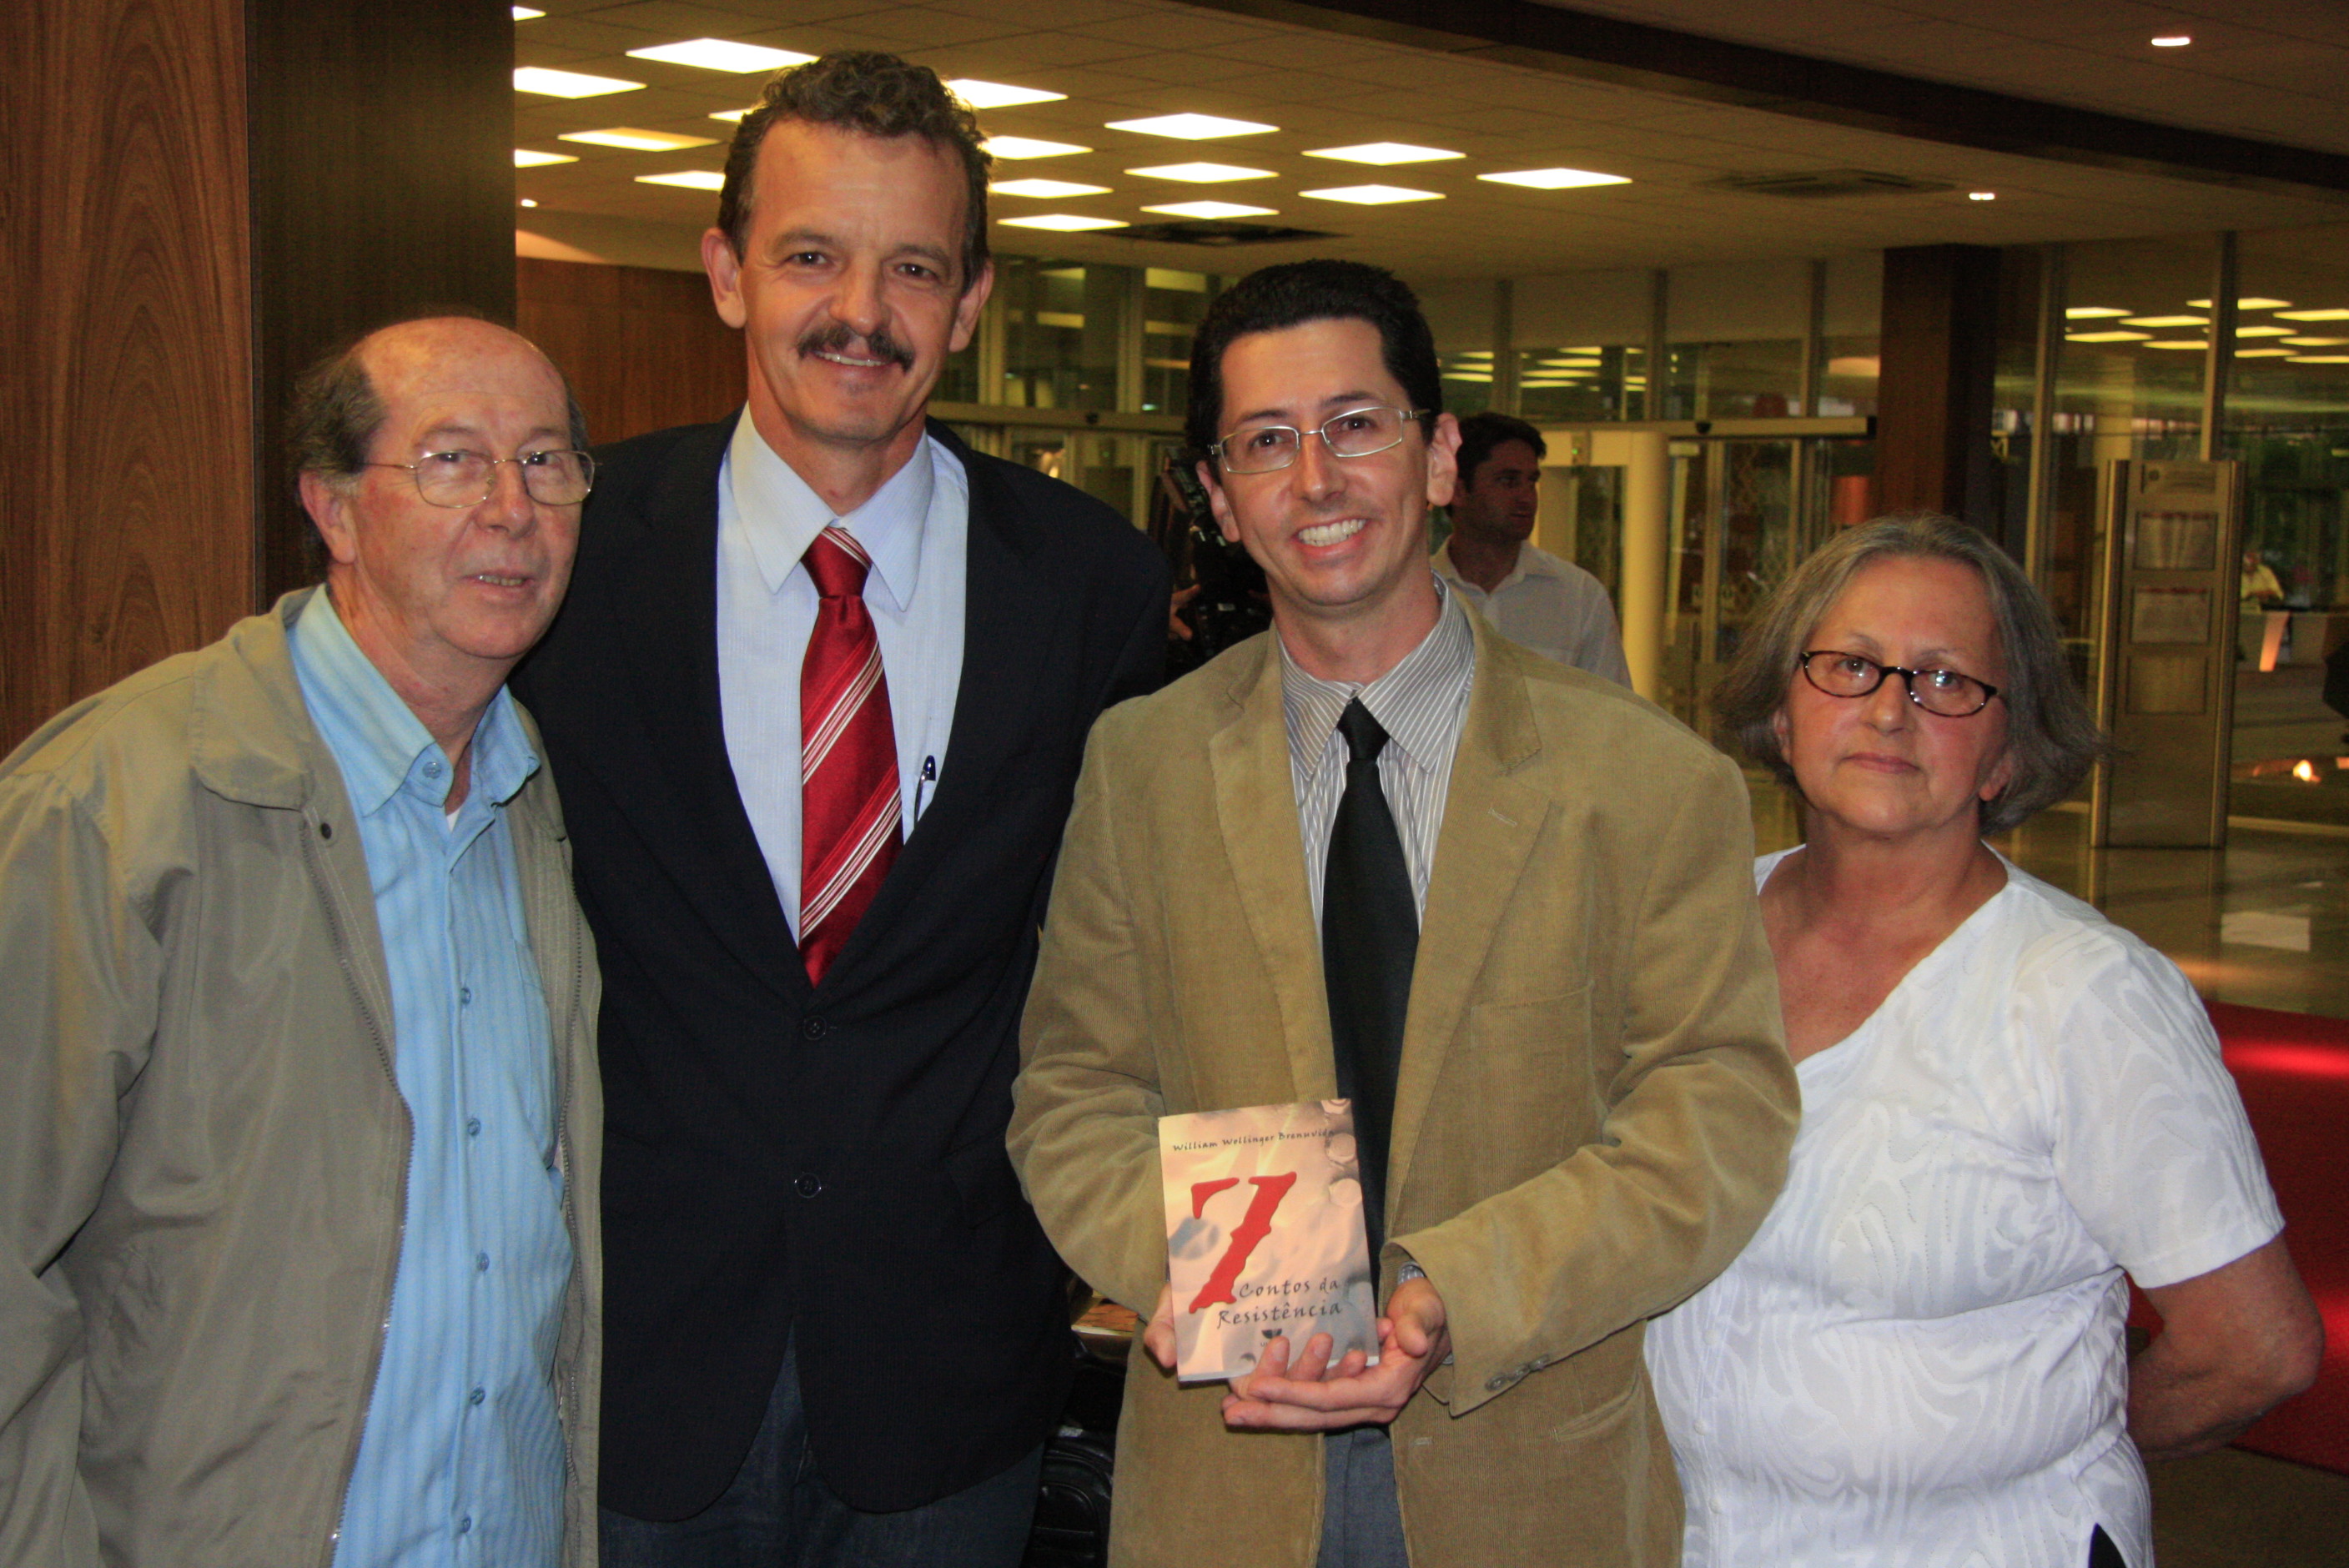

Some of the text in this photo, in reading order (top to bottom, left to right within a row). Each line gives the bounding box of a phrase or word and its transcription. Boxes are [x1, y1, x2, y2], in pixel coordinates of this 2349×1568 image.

[1173, 1141, 1218, 1151] William
[1222, 1134, 1275, 1148] Wollinger
[1189, 1171, 1297, 1314] 7
[1239, 1278, 1340, 1298] Contos da
[1217, 1300, 1343, 1329] Resistência
